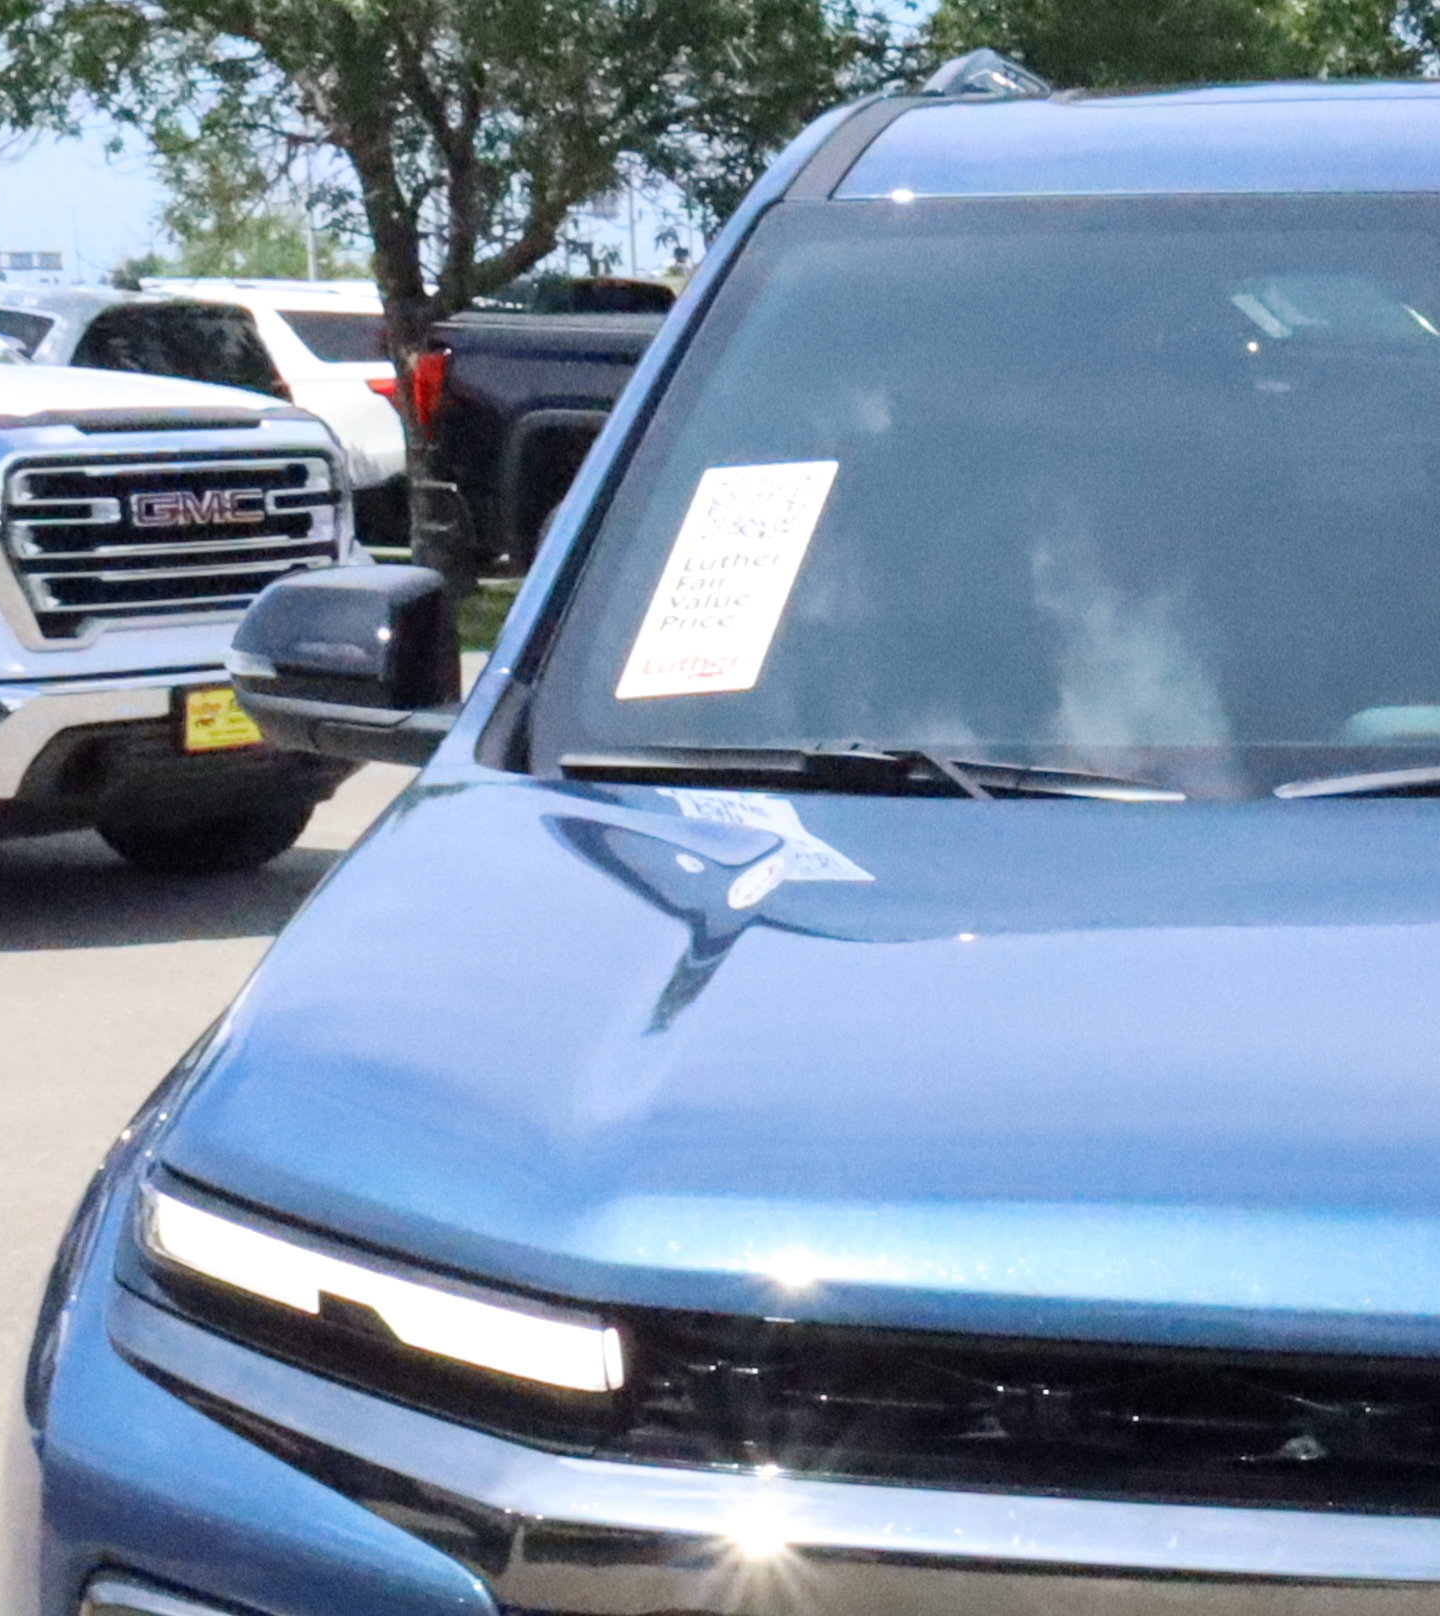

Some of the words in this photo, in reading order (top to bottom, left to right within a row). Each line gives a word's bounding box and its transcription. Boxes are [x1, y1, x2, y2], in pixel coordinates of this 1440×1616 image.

[130, 488, 265, 527] GMC
[683, 553, 782, 572] Luther
[675, 575, 727, 591] Fair
[670, 594, 751, 610] Value
[661, 615, 735, 631] Price
[642, 656, 741, 676] Luther
